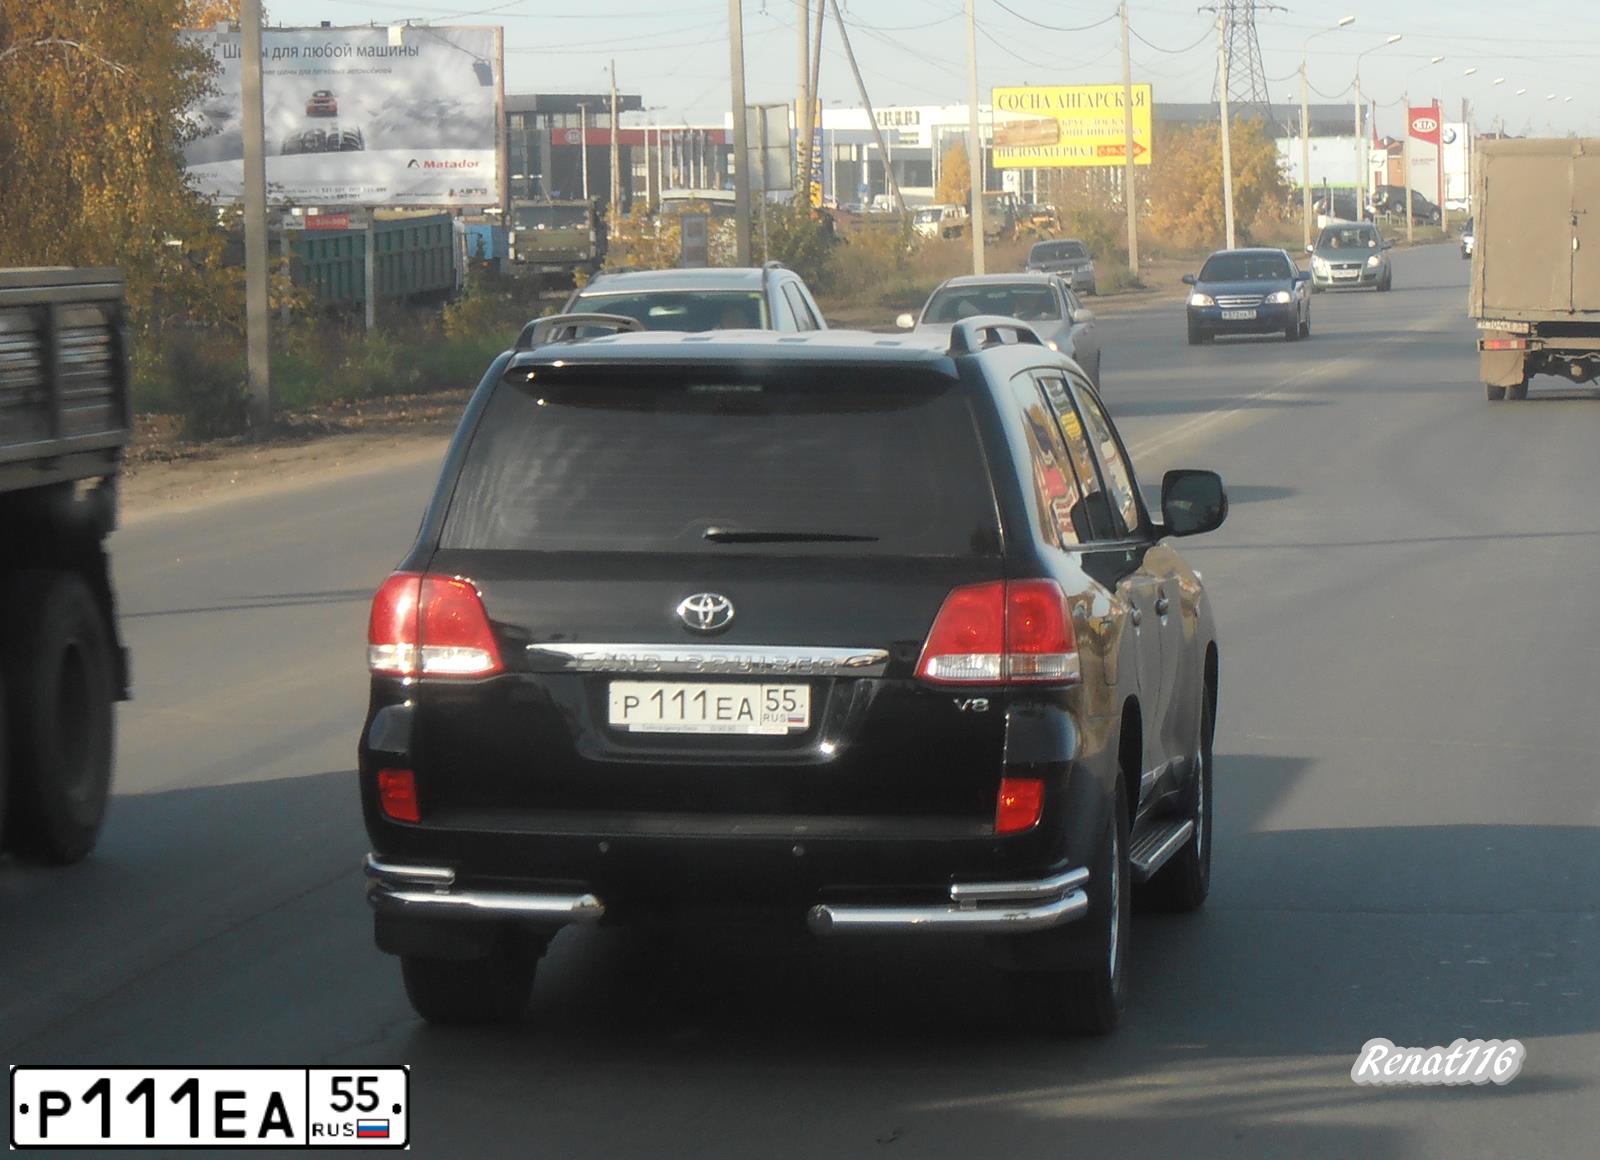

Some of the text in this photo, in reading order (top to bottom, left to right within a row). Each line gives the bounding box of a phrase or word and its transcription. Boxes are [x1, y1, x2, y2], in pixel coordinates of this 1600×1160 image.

[223, 42, 419, 61] Шы для любой машины
[998, 92, 1051, 110] СОСНА
[1414, 120, 1435, 129] KIA
[423, 160, 481, 169] Matador
[766, 689, 796, 712] 55
[953, 698, 989, 712] V8
[763, 714, 787, 723] RUS
